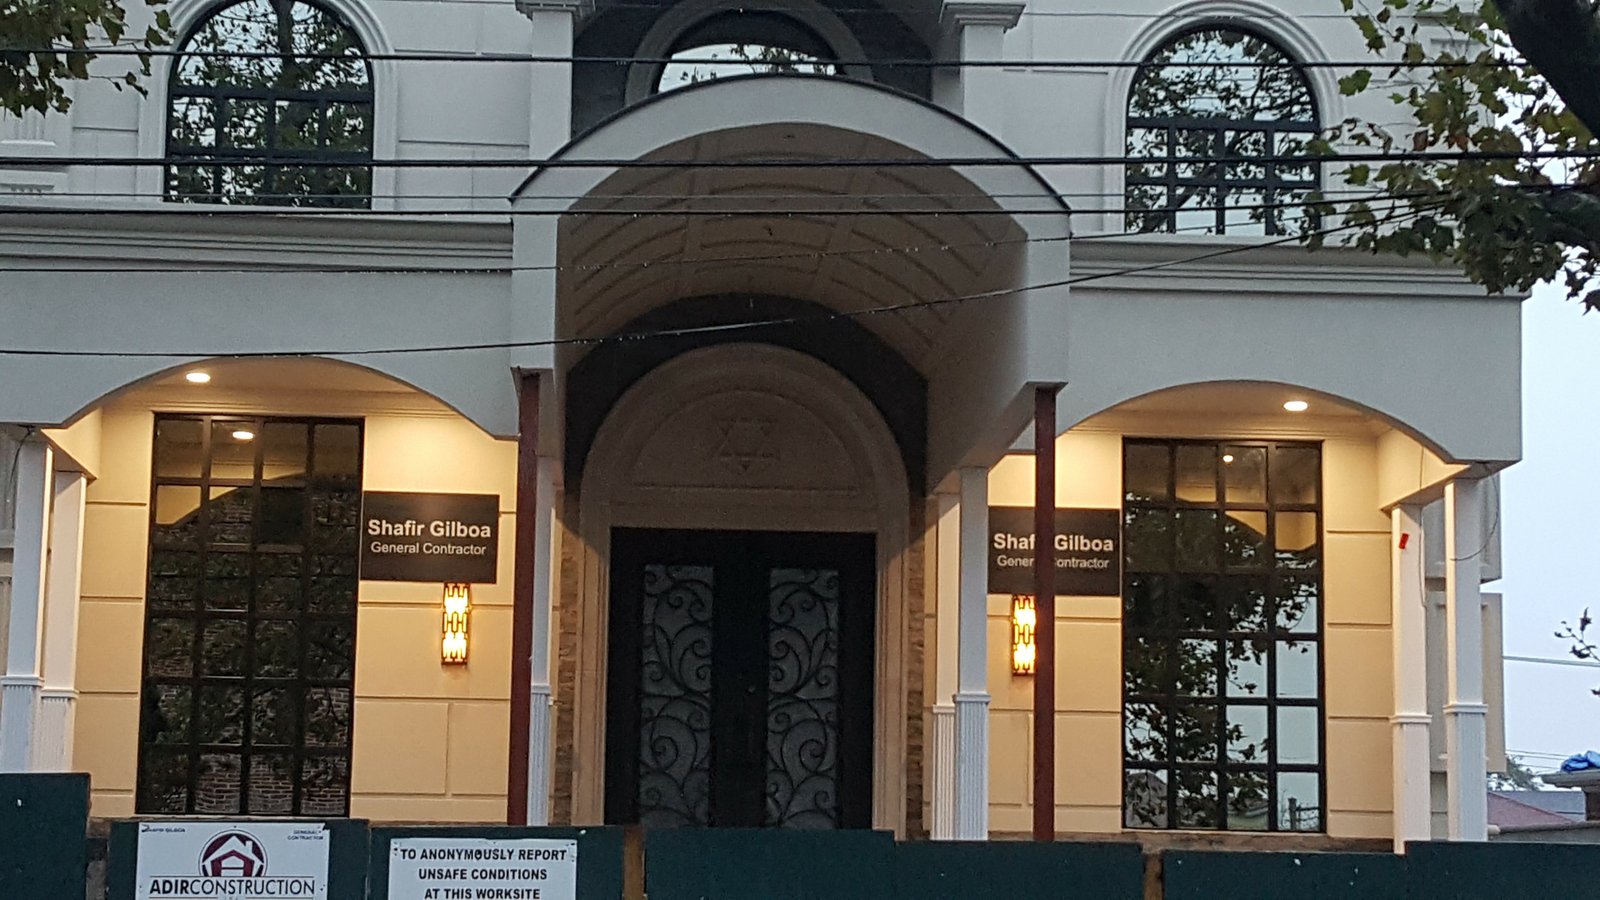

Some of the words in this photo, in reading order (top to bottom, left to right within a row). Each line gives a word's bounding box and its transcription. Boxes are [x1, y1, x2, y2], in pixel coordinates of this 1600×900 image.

[367, 519, 425, 536] Shafir
[430, 521, 491, 538] Gilboa
[370, 541, 419, 554] General
[423, 543, 486, 555] Contractor
[993, 533, 1036, 550] Shaf
[1054, 535, 1114, 552] Gilboa
[997, 555, 1035, 567] Gener
[1055, 557, 1109, 568] ontractor
[400, 849, 416, 860] TO
[420, 849, 514, 860] ANONYMOUSLY
[518, 849, 567, 861] REPORT
[418, 868, 467, 880] UNSAFE
[471, 868, 548, 880] CONDITIONS
[424, 889, 440, 899] AT
[444, 889, 472, 899] THIS
[476, 889, 540, 899] WORKSITE
